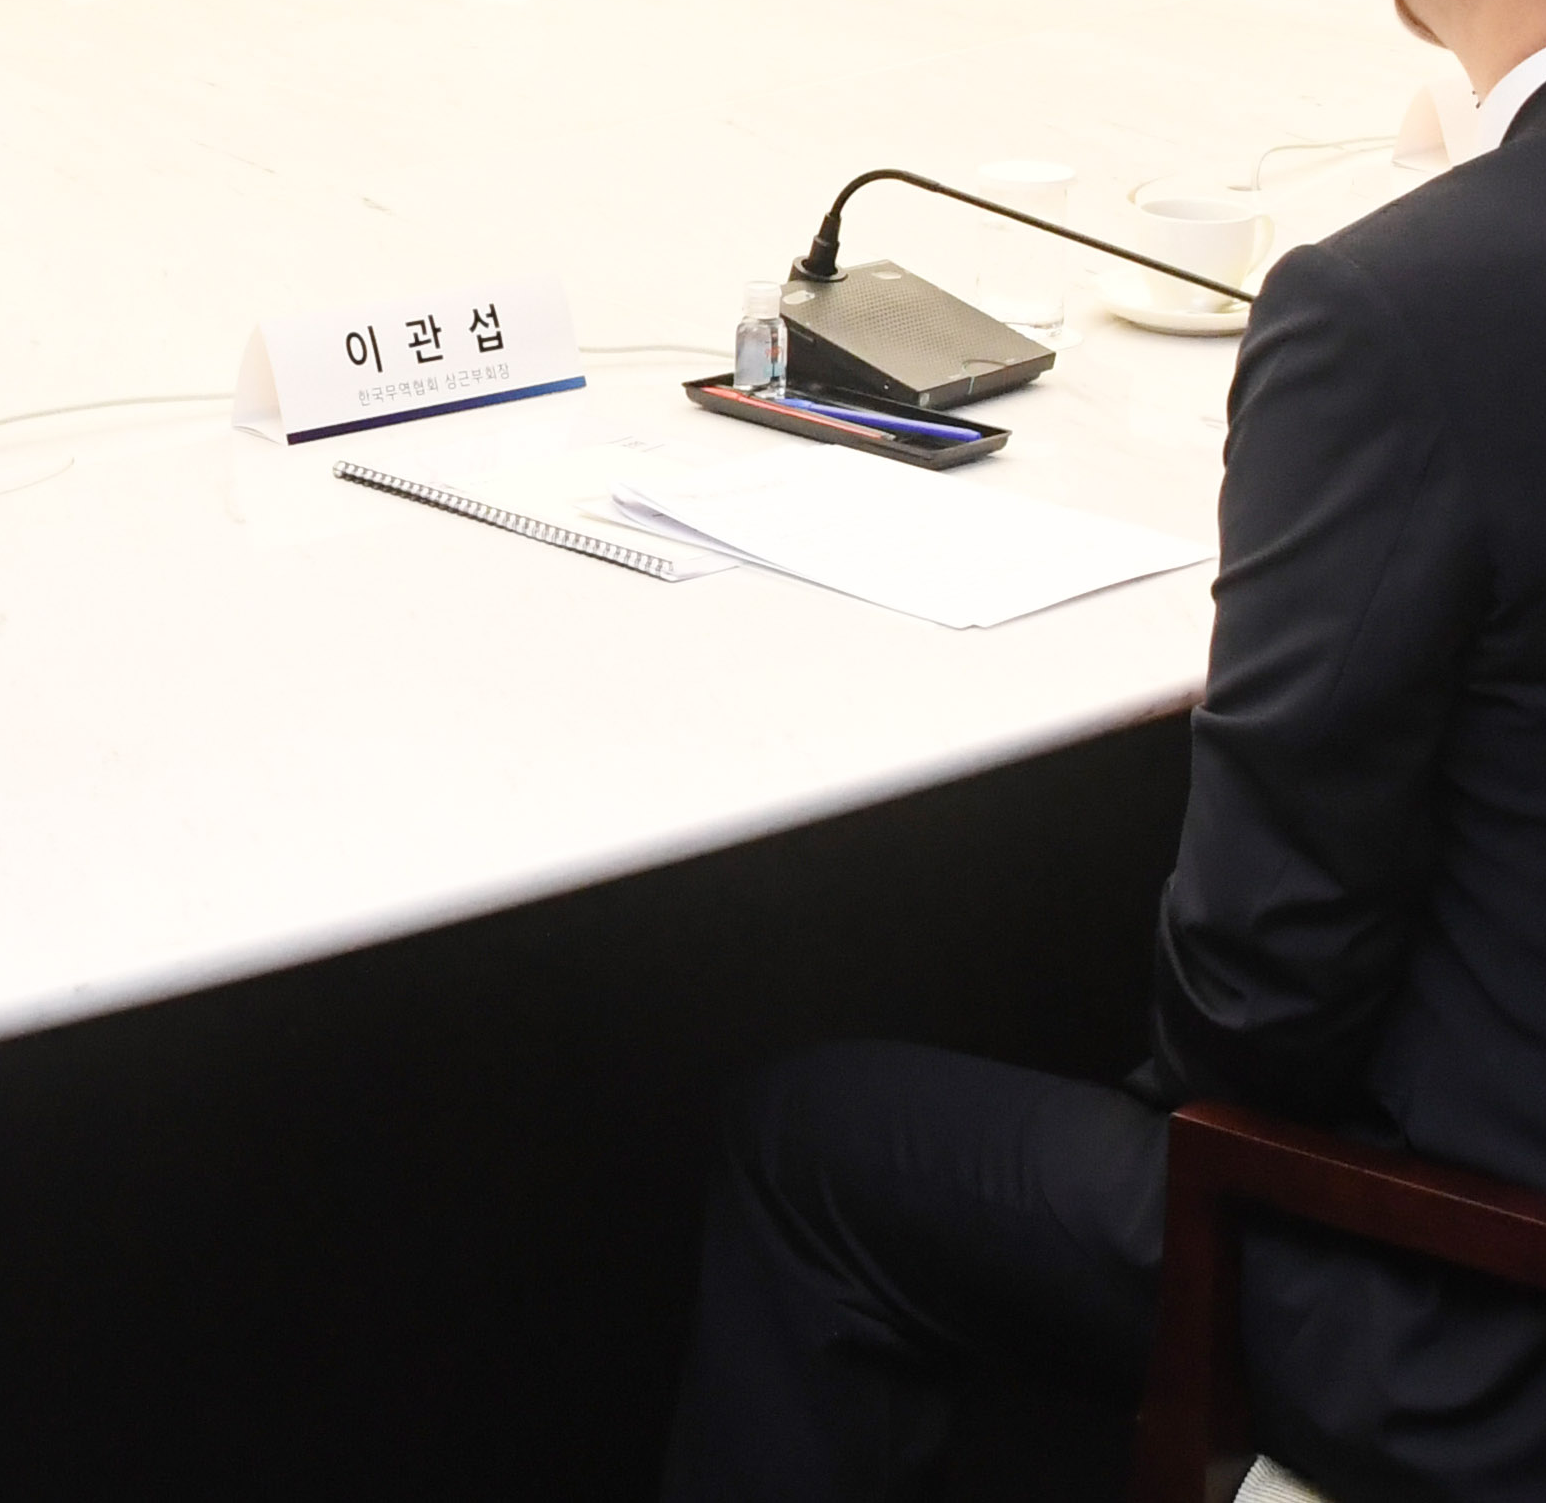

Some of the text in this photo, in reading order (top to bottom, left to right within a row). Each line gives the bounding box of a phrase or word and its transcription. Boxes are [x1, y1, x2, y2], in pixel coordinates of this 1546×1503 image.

[345, 303, 504, 373] 이관섭
[358, 362, 511, 406] 한국무역협회 상근부회장
